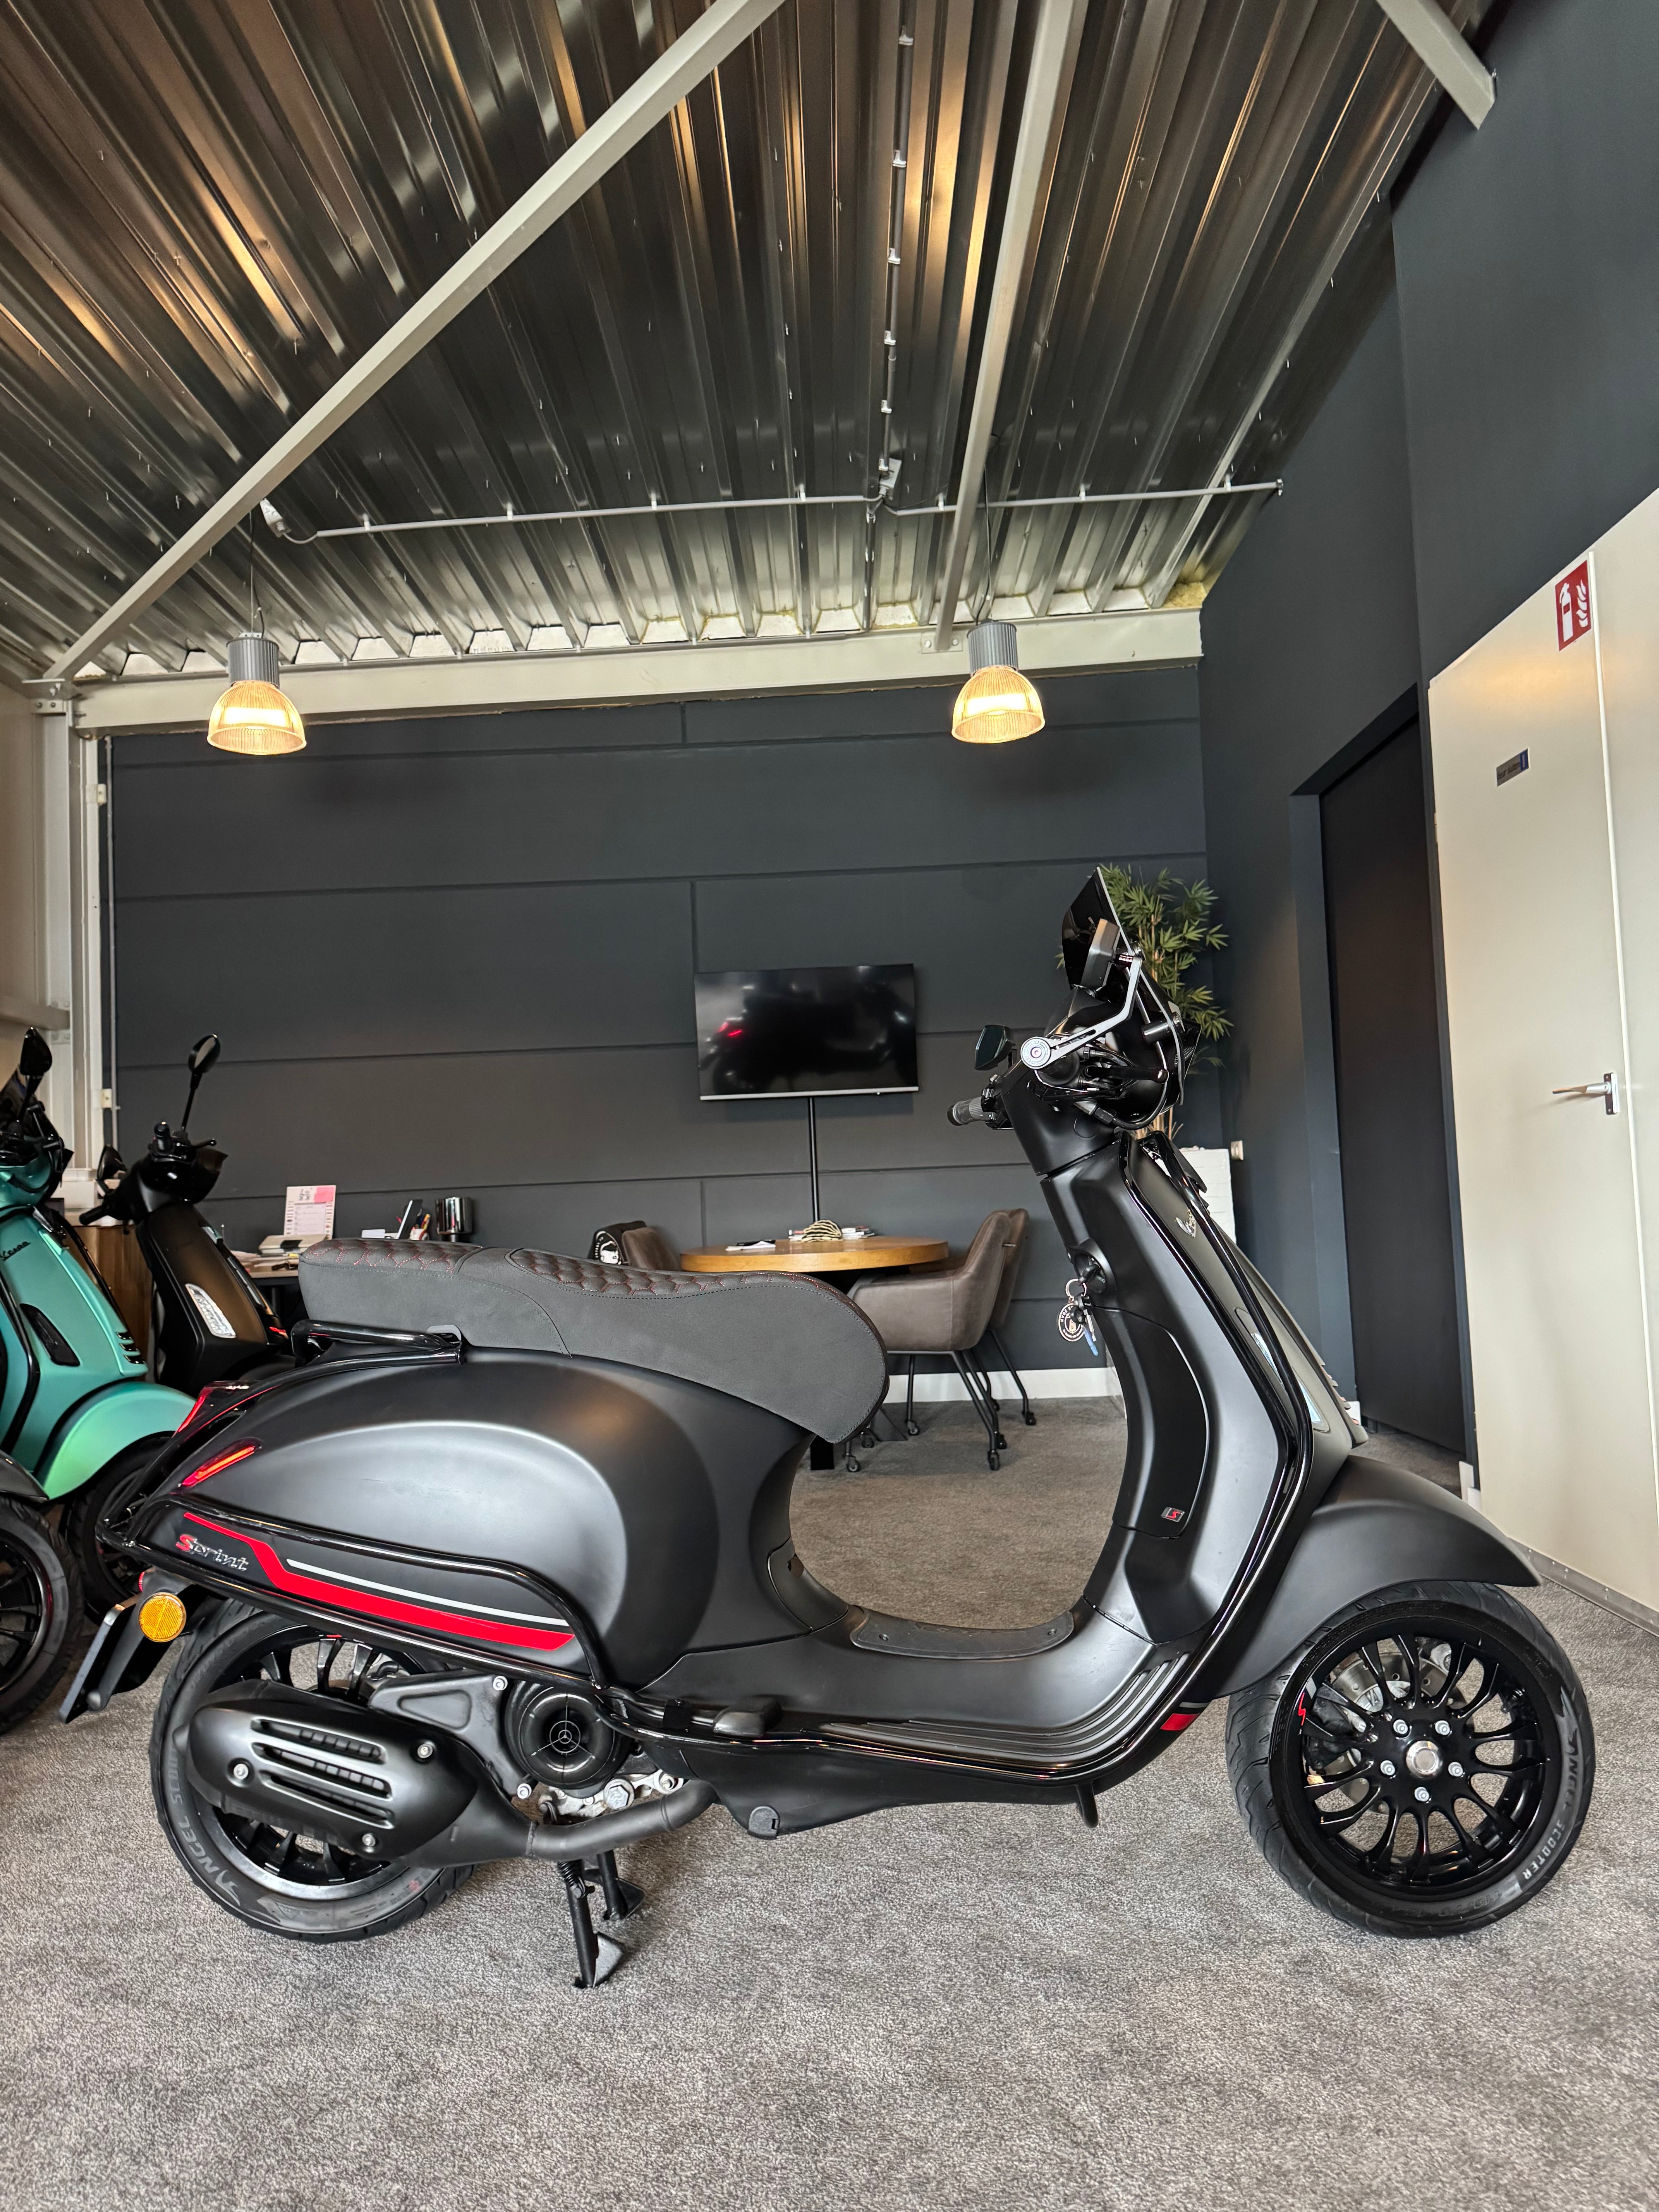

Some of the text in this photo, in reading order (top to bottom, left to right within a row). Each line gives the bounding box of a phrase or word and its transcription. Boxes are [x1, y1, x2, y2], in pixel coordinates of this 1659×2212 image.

[175, 1534, 249, 1571] Sprint
[168, 1746, 183, 1804] SCOOT
[1522, 1819, 1565, 1880] SCOOTER
